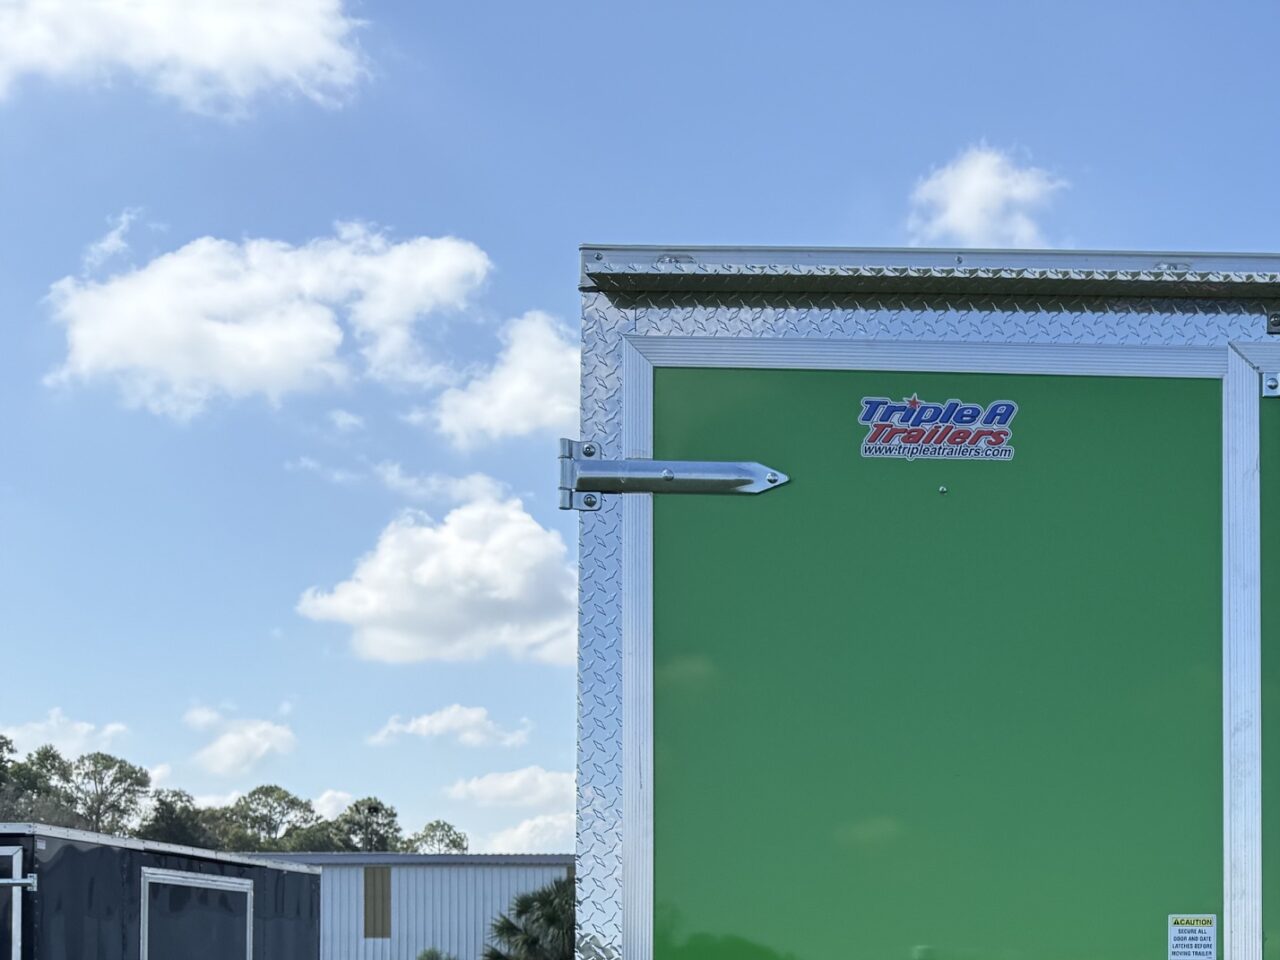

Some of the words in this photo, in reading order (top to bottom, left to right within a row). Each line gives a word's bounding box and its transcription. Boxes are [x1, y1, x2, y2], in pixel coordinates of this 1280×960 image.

[861, 399, 980, 427] Triple
[983, 402, 1015, 425] A
[868, 424, 1009, 446] Trailers
[864, 445, 1012, 458] www.tripleatrailers.com
